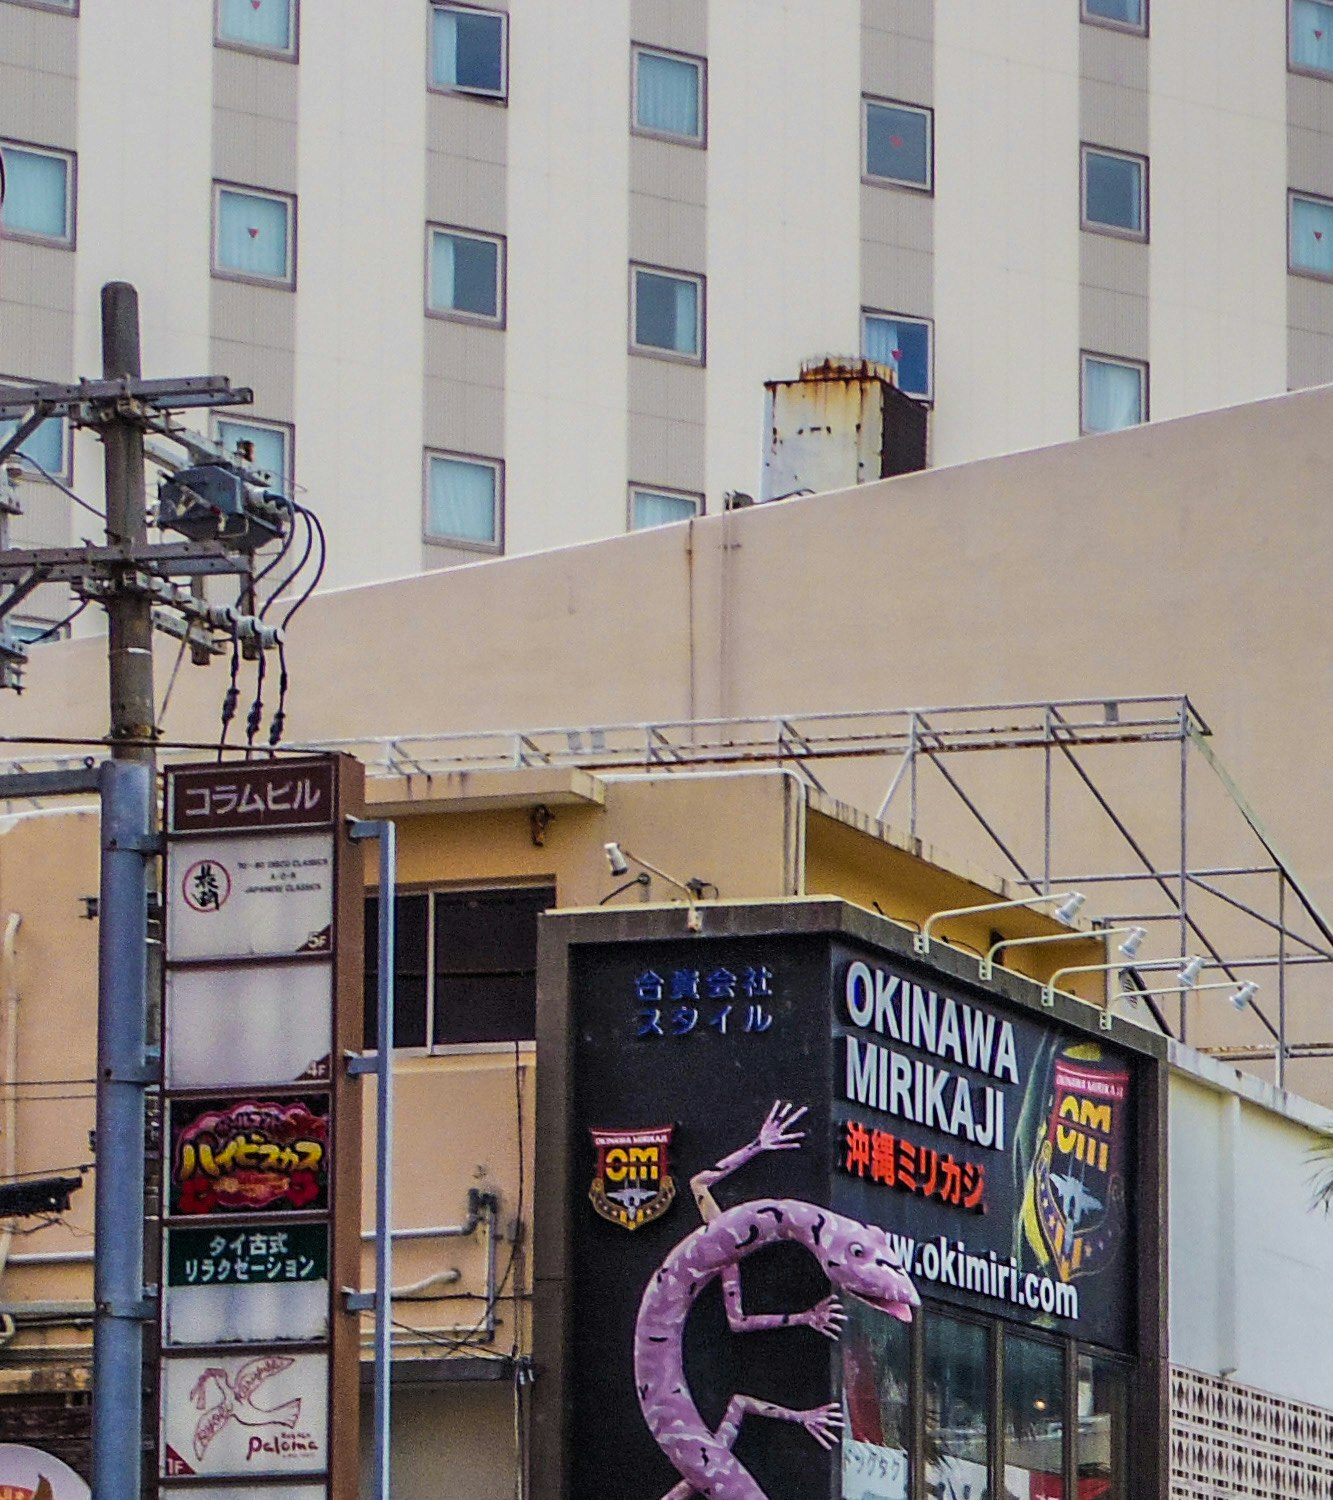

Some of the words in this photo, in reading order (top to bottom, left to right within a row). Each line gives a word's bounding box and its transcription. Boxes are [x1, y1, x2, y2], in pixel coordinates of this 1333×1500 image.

[185, 779, 321, 817] コラムビル
[308, 932, 327, 948] 5F
[636, 1004, 773, 1037] スタイル
[845, 961, 1019, 1085] OKINAWA
[306, 1060, 326, 1077] 4F
[845, 1034, 1005, 1151] MIRIKAJI
[843, 1119, 988, 1214] 沖縄ミリカジ
[209, 1232, 289, 1256] タイ古式
[185, 1256, 315, 1282] リラクゼーション
[884, 1231, 1079, 1320] w.okimiri.com
[246, 1435, 319, 1461] Paloma
[167, 1458, 184, 1475] 1F
